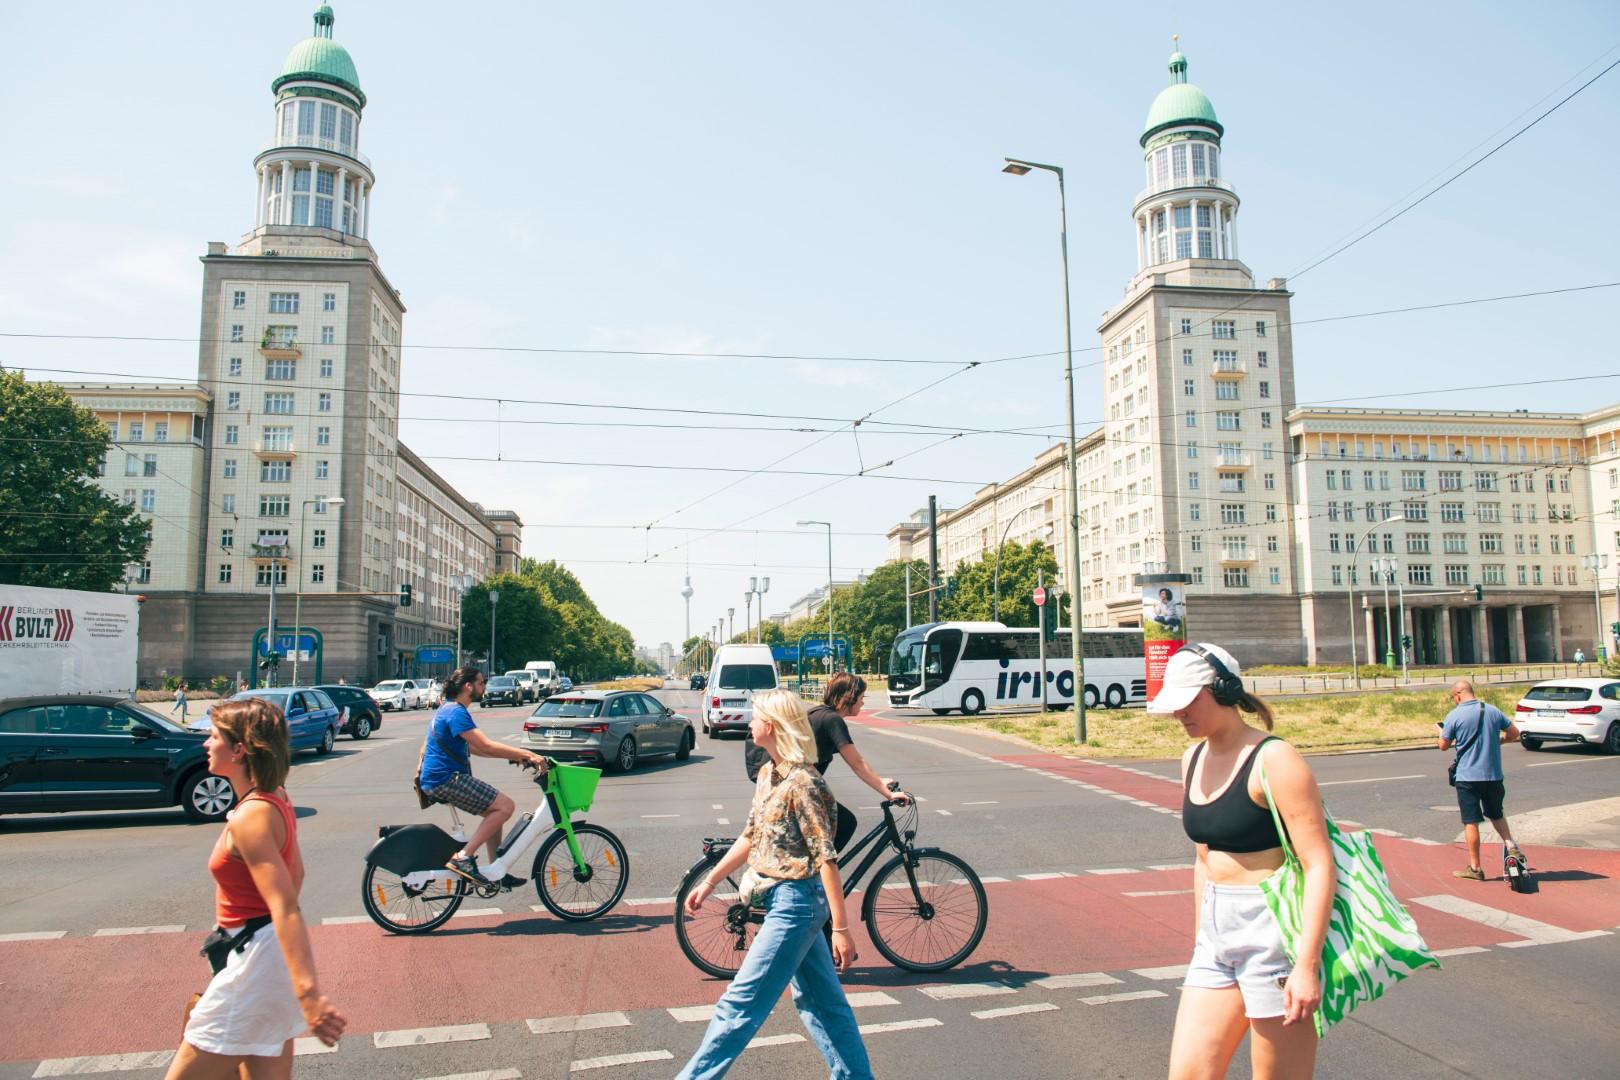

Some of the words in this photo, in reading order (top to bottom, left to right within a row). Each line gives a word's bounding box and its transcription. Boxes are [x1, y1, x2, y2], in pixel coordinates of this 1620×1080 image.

[17, 606, 54, 615] BERLINER
[15, 617, 54, 638] BVLT
[282, 637, 292, 648] U
[431, 650, 438, 658] U
[996, 657, 1075, 699] irro
